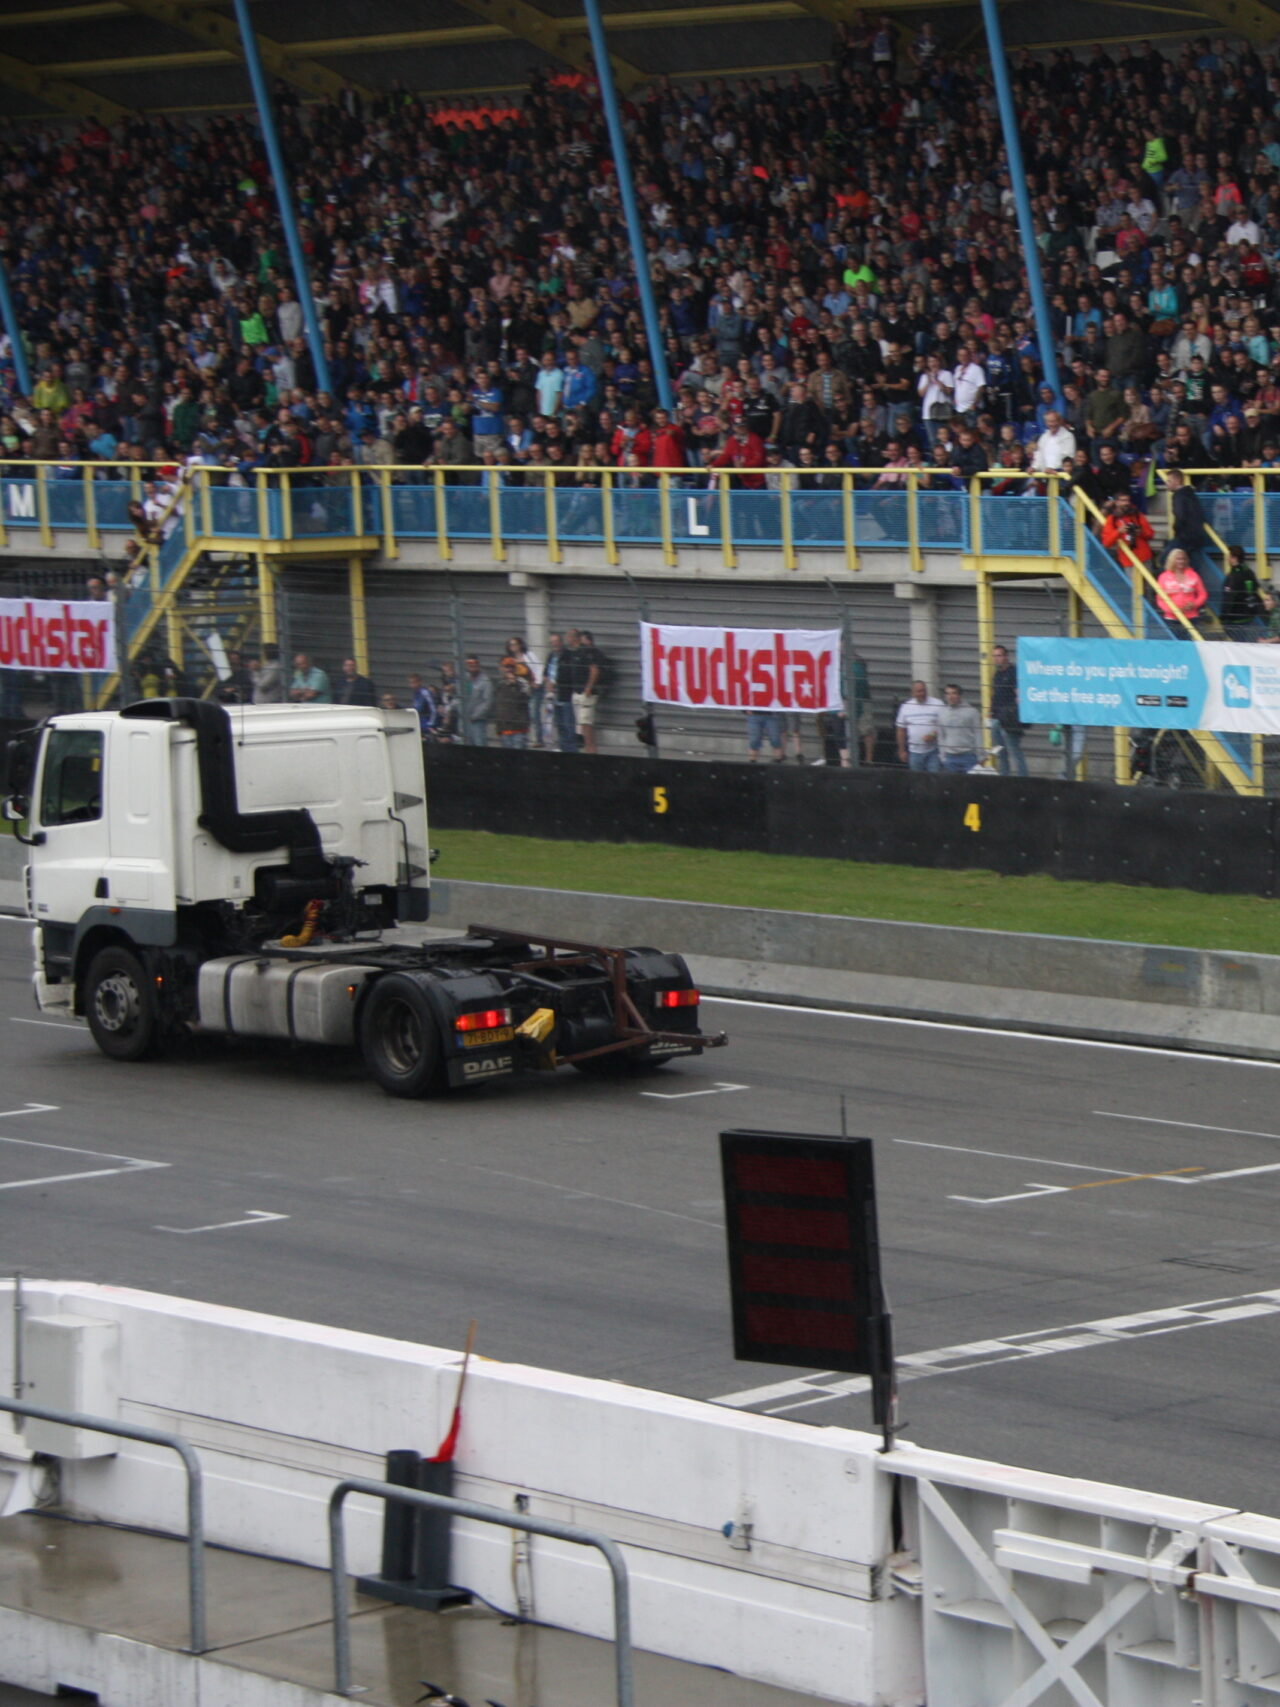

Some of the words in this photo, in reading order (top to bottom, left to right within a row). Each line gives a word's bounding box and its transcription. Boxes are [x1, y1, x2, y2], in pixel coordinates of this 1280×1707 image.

[8, 484, 35, 517] M
[687, 497, 709, 536] L
[650, 627, 832, 709] truckstar
[1025, 660, 1064, 675] Where
[1067, 662, 1084, 676] do
[1085, 665, 1107, 681] you
[1109, 663, 1137, 681] park
[1138, 664, 1189, 683] tonight?
[1027, 687, 1049, 702] Get
[1049, 688, 1069, 703] the
[1071, 687, 1094, 703] free
[1096, 692, 1121, 707] app
[653, 786, 668, 814] 5
[963, 802, 981, 833] 4
[463, 1056, 513, 1073] DAF
